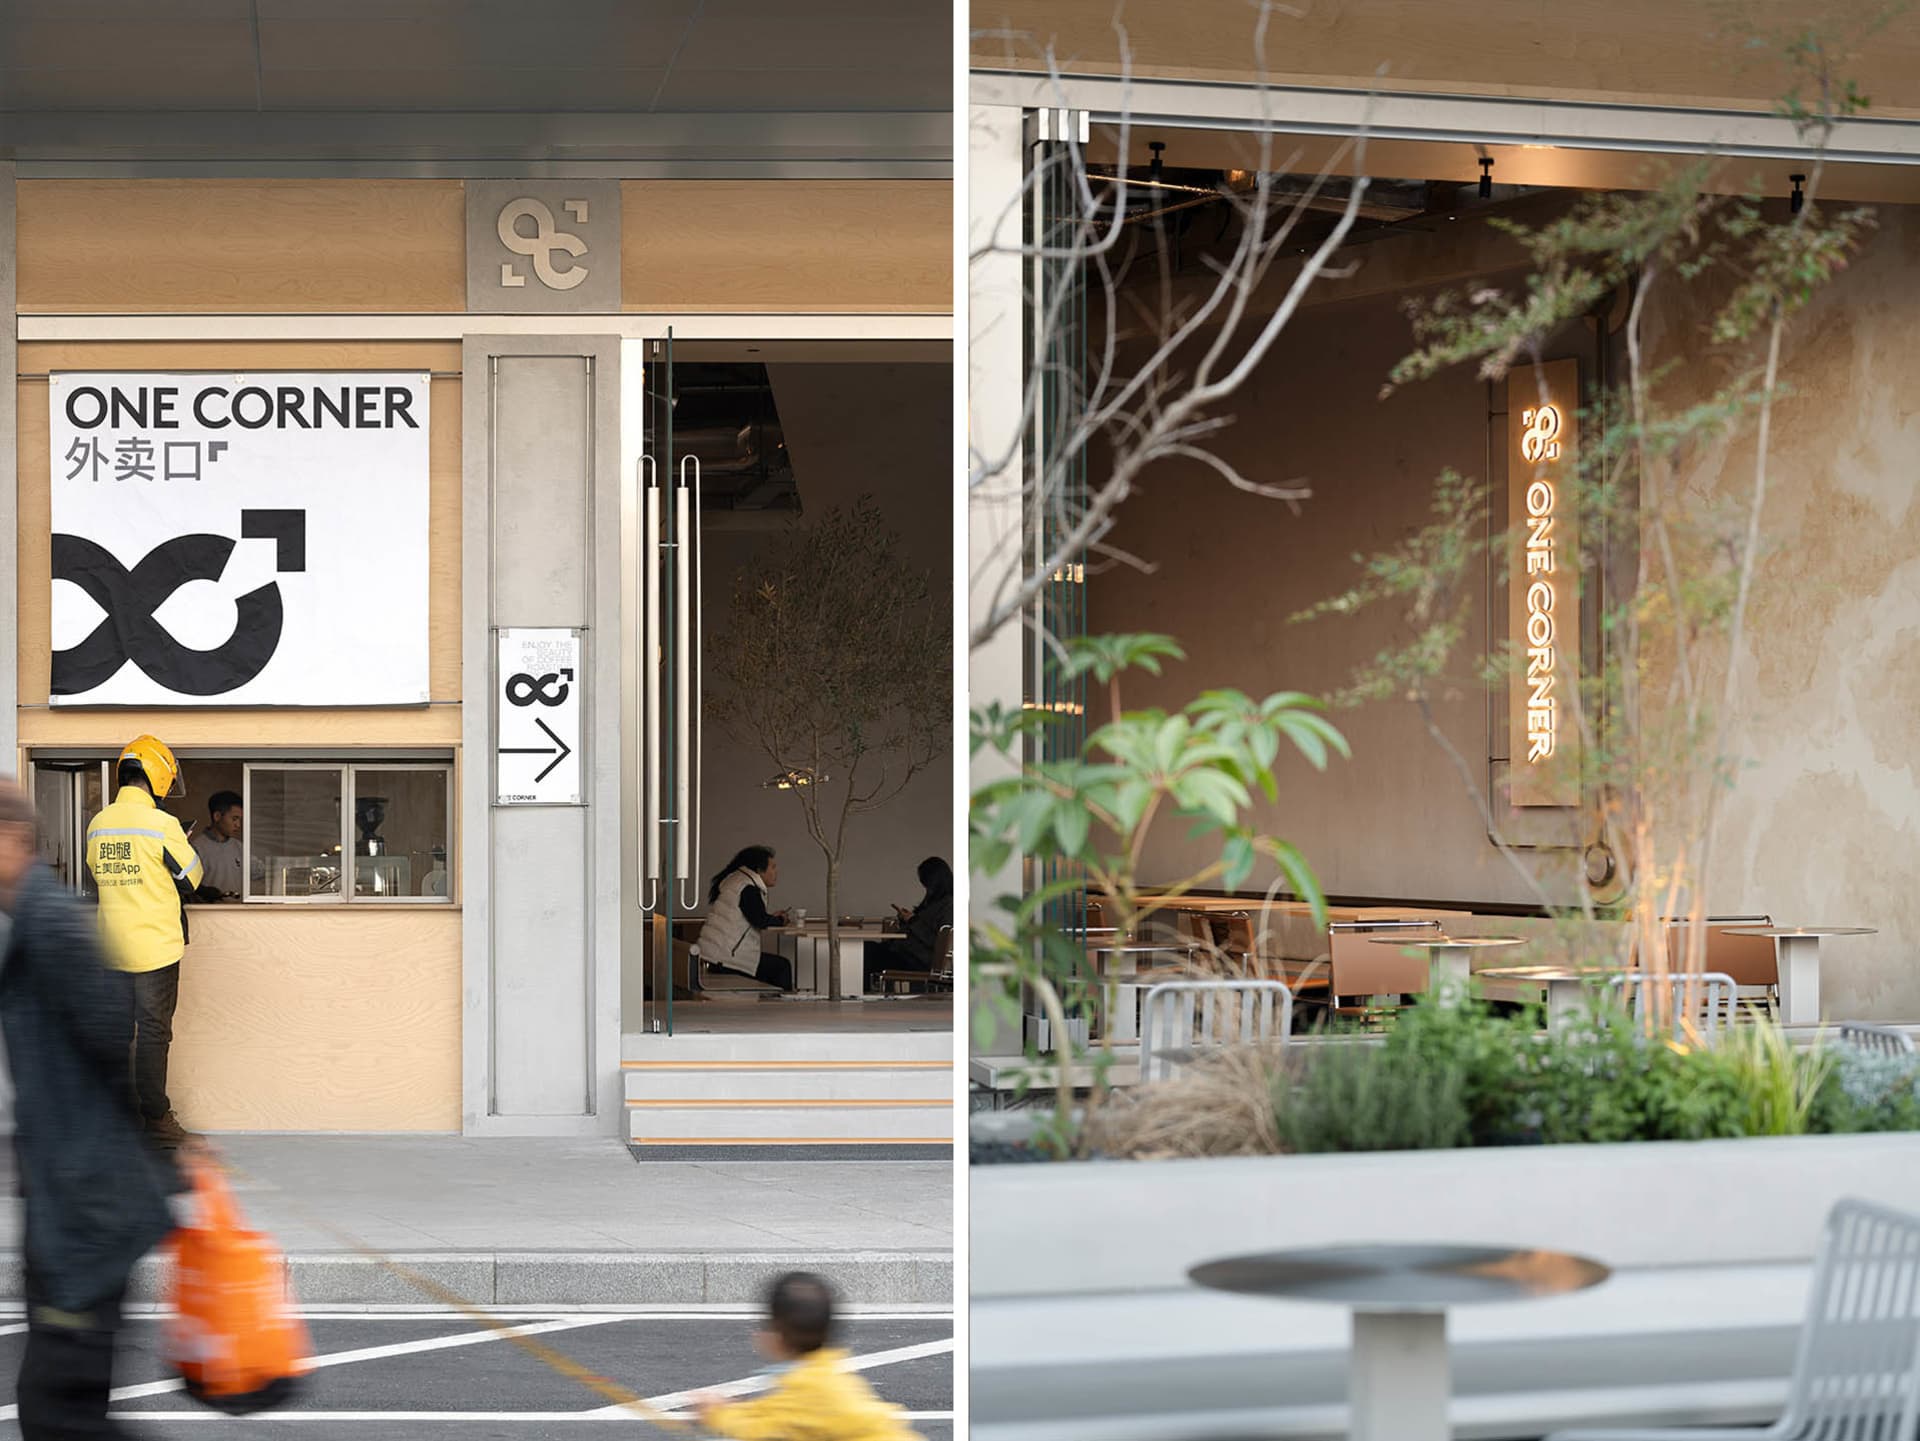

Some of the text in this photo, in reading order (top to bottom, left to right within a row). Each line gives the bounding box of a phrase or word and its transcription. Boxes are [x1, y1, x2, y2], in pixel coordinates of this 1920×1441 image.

[66, 387, 419, 429] ONE CORNER
[65, 436, 202, 482] 外卖口
[1527, 482, 1552, 761] ONE CORNER
[100, 842, 131, 860] 跑腿
